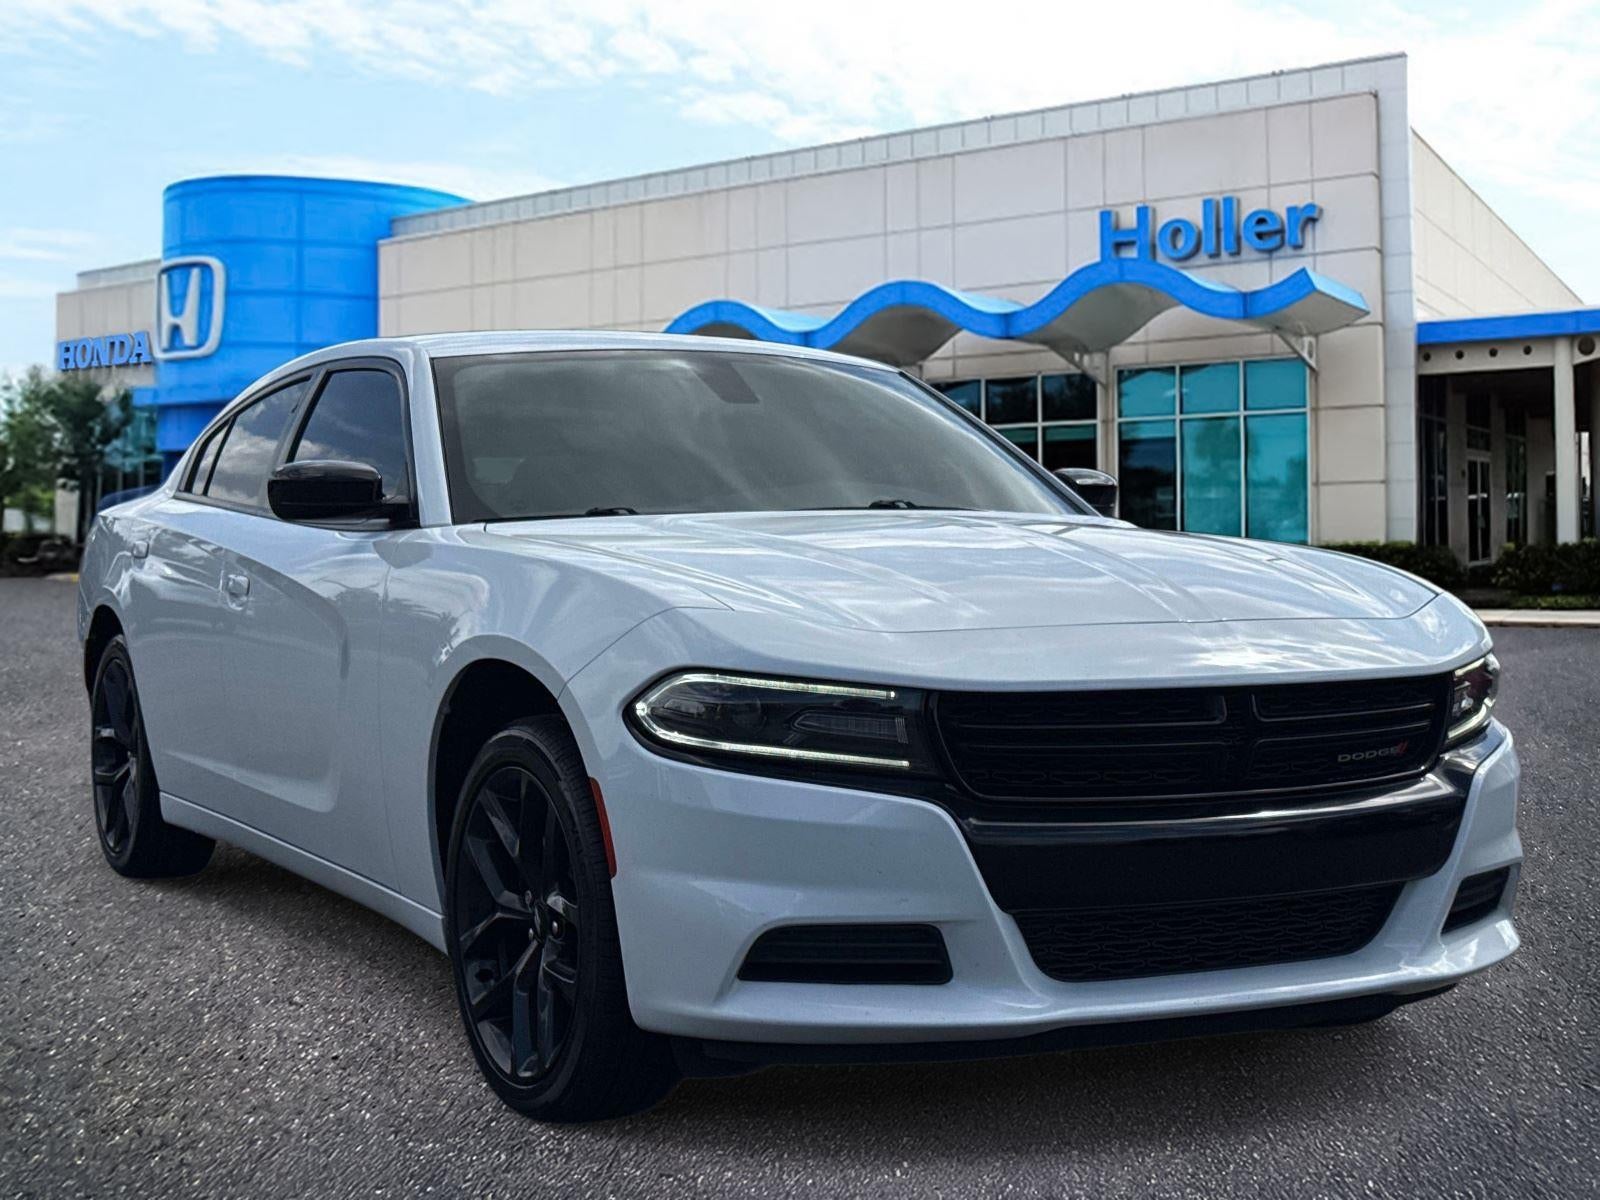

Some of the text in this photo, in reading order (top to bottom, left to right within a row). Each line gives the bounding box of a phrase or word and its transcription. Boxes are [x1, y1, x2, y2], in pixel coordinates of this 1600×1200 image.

[1099, 196, 1321, 262] Holler
[58, 331, 152, 371] HONDA
[1337, 746, 1400, 762] DODGE
